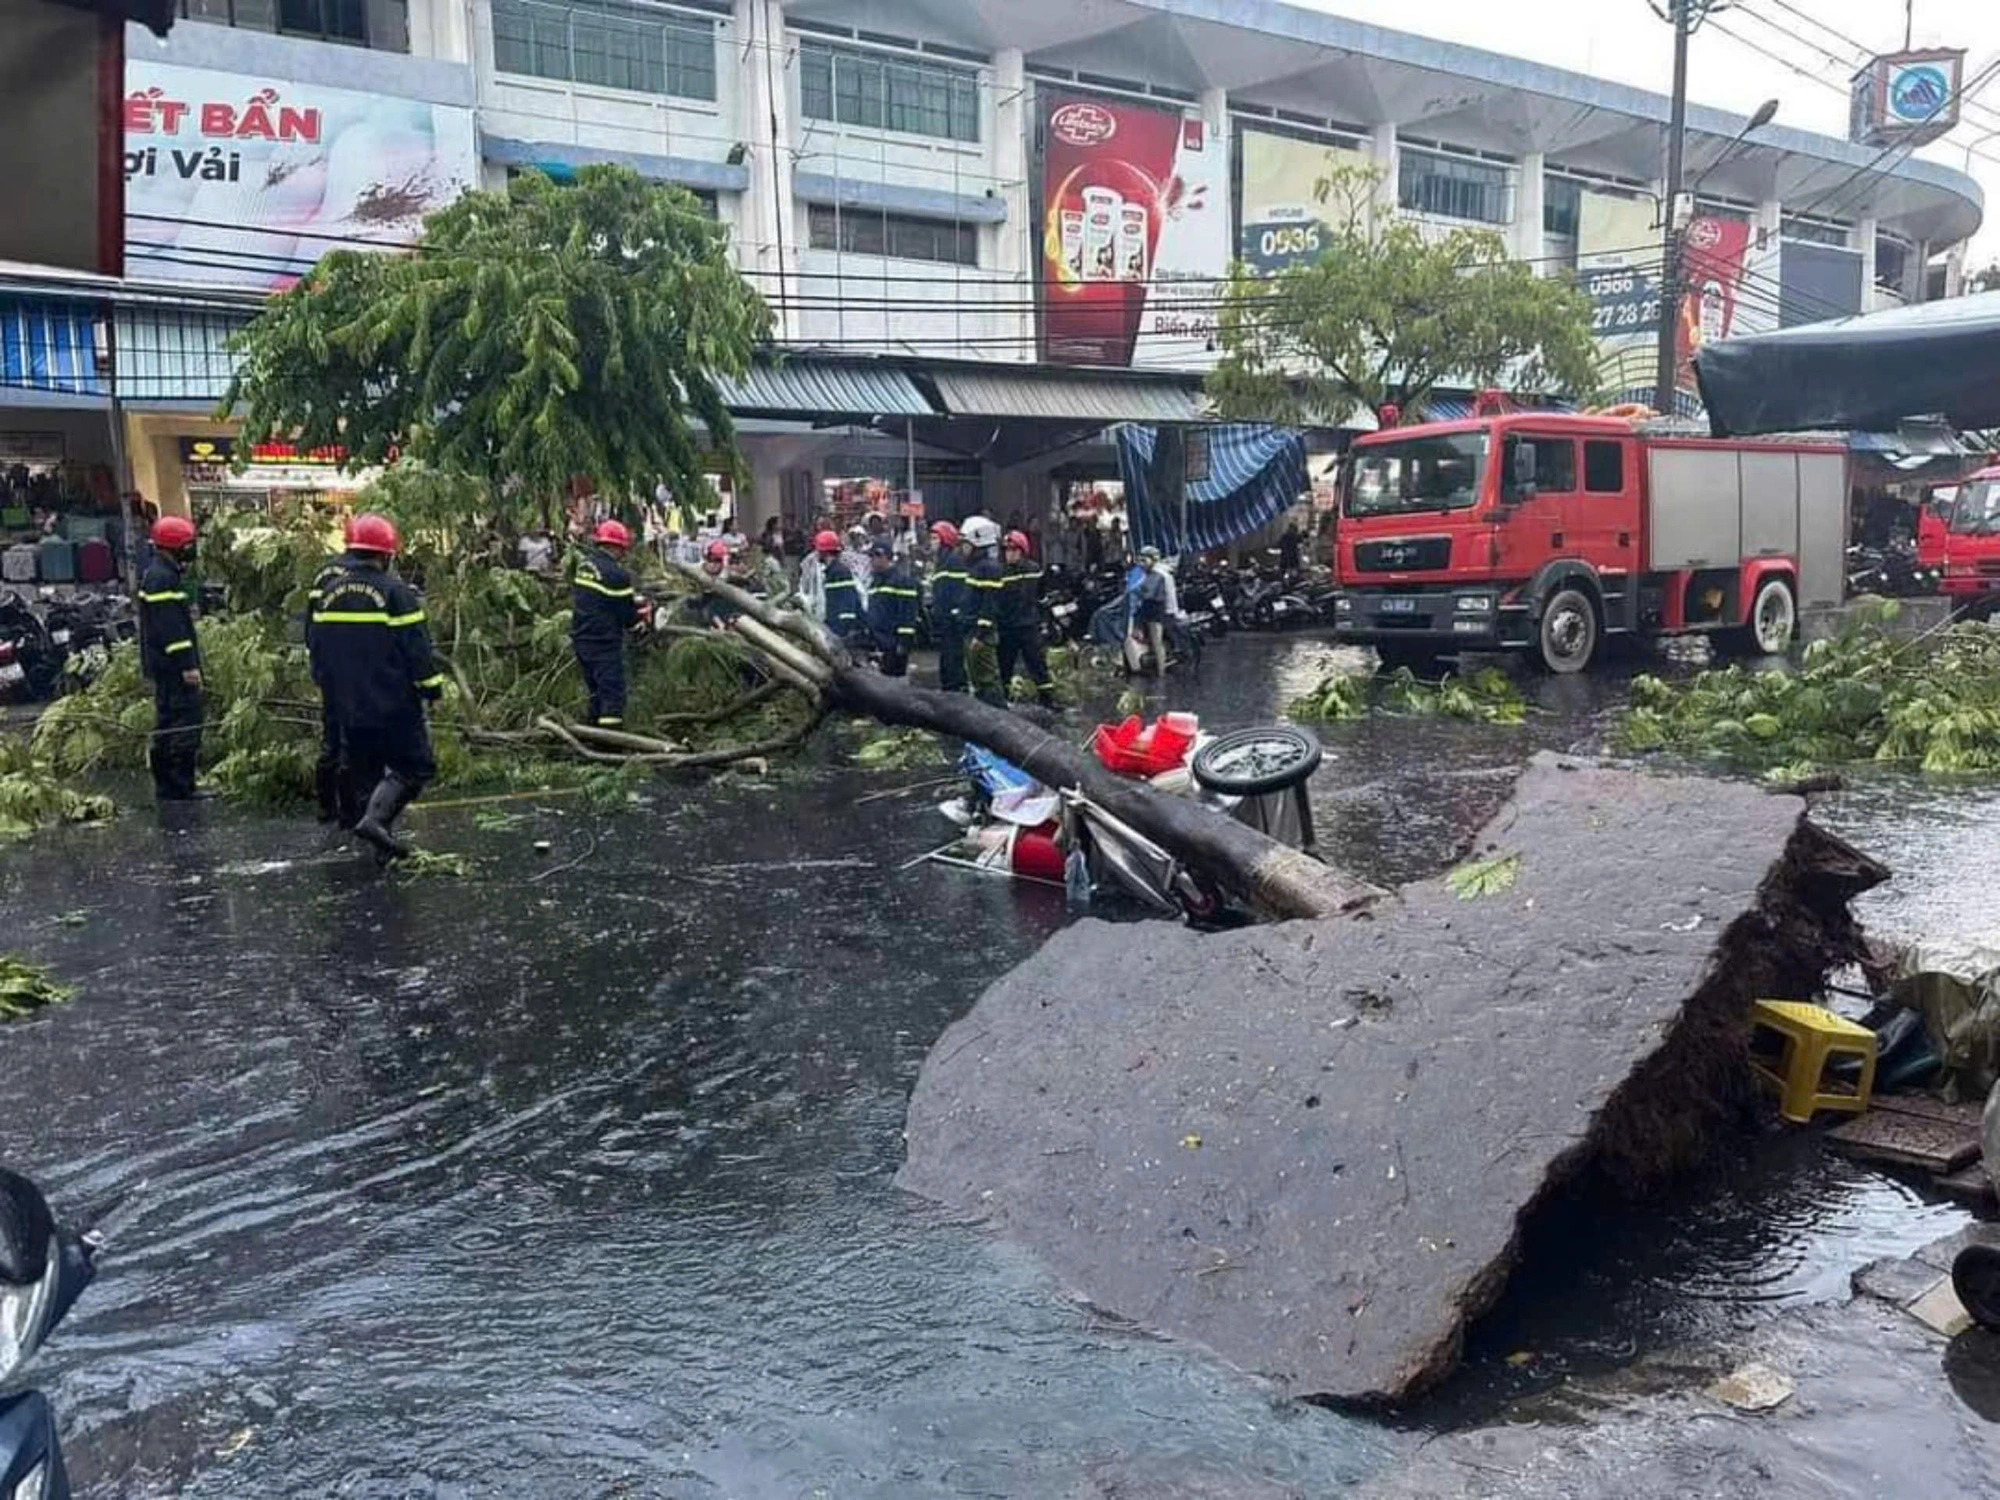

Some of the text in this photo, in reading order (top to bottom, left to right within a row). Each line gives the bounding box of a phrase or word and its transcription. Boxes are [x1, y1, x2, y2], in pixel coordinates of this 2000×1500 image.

[202, 88, 321, 144] BẨN
[171, 146, 240, 182] Vải
[1591, 305, 1614, 329] 27
[1616, 301, 1638, 326] 28
